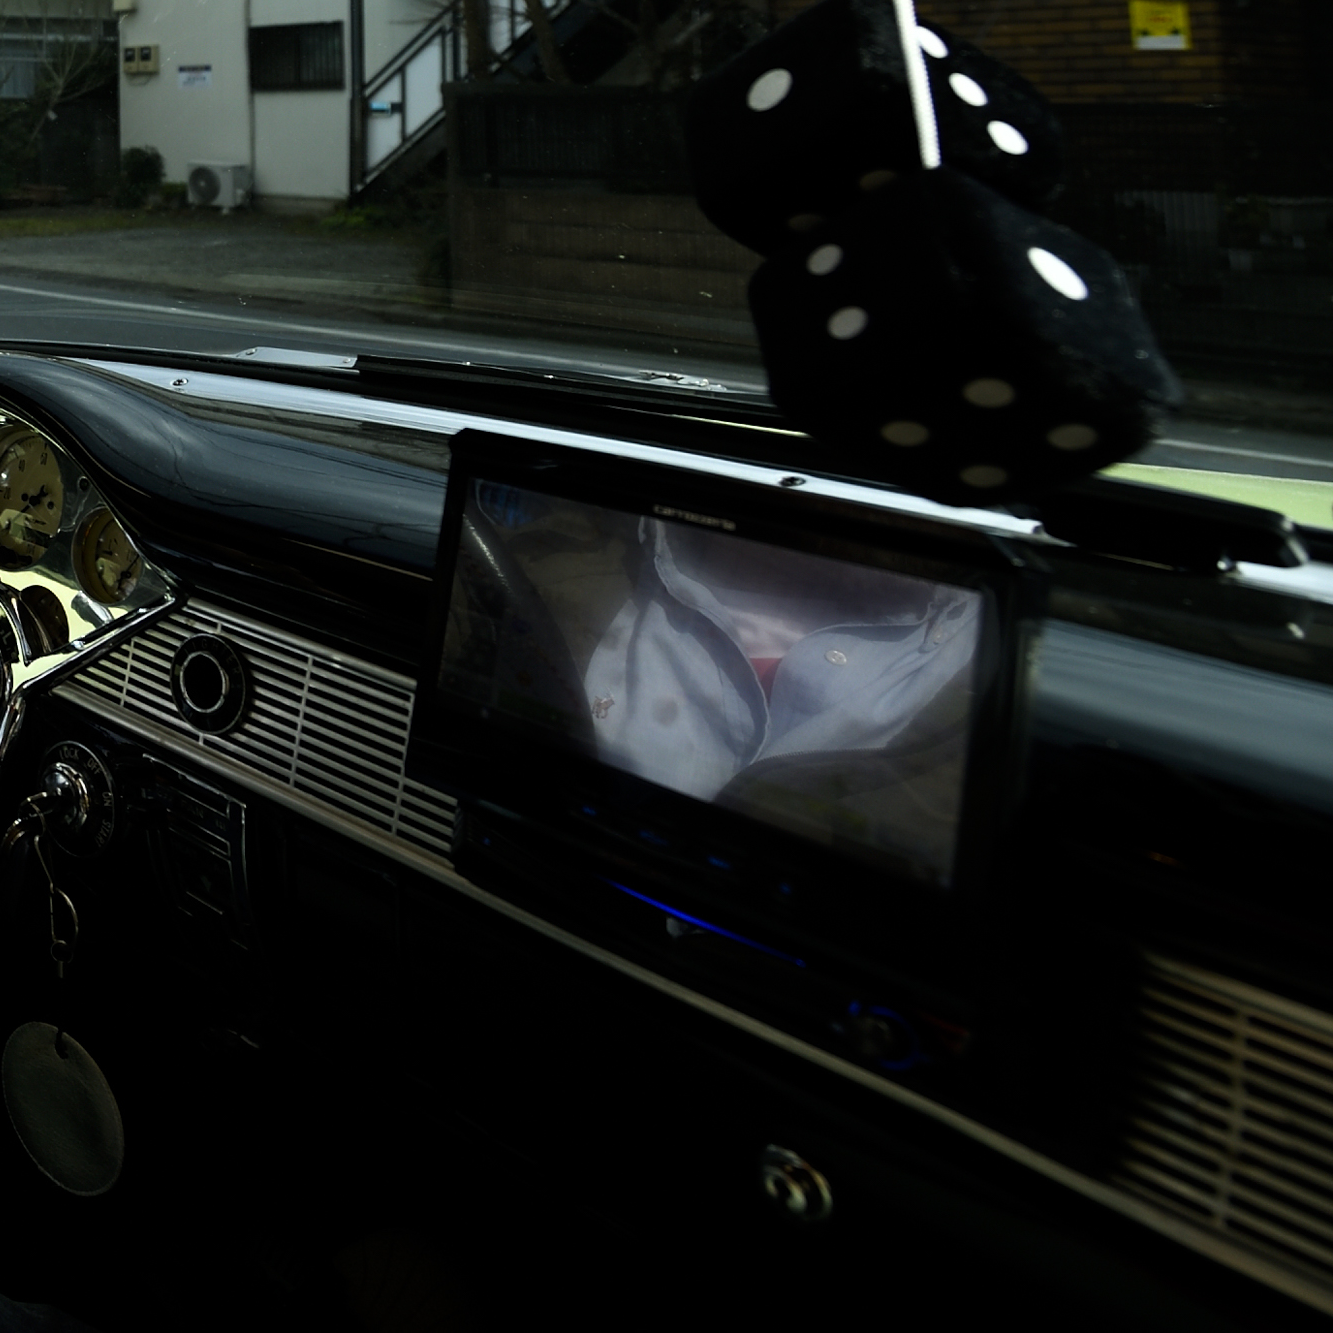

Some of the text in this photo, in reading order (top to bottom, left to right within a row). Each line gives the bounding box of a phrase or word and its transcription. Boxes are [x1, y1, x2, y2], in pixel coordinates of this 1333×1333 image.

[183, 638, 242, 675] LIGHTER
[59, 745, 113, 848] LOCK OFF ON START
